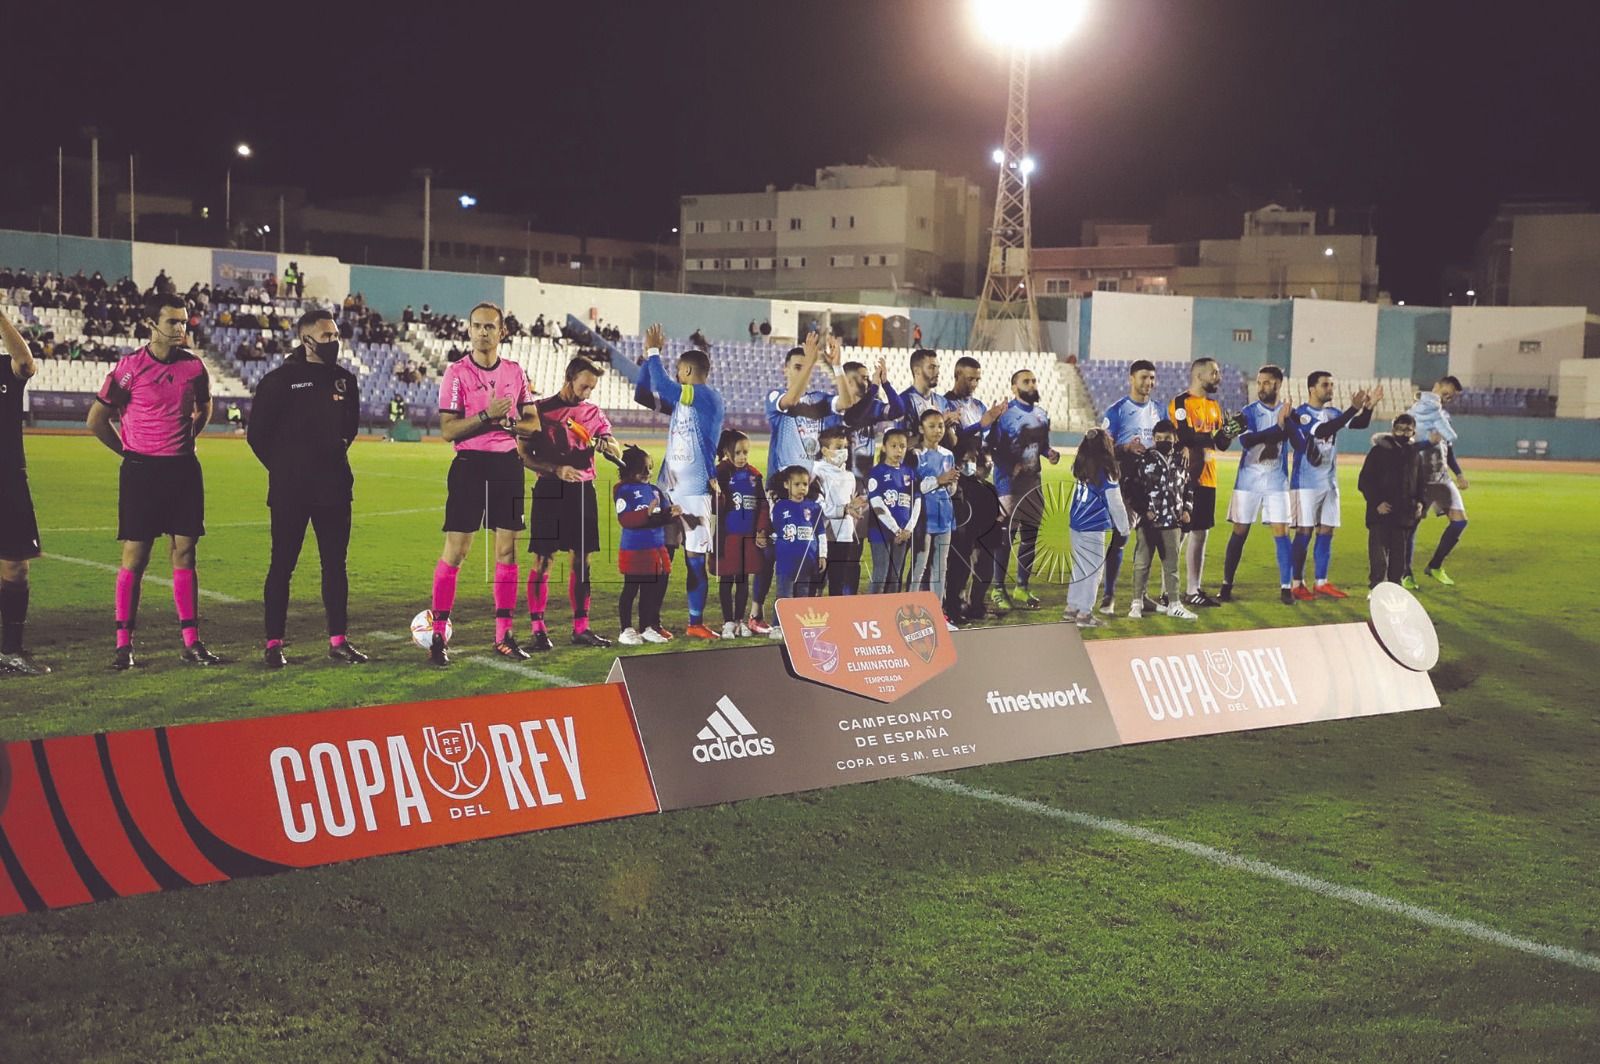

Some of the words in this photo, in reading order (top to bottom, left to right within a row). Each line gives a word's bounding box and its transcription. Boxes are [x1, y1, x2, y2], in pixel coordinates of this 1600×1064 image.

[853, 620, 882, 640] VS
[854, 645, 894, 656] PRIMERA
[847, 658, 911, 673] ELIMINATORIA
[863, 674, 903, 684] TEMPORADA
[1130, 654, 1220, 720] COPA
[1237, 647, 1298, 709] REY
[878, 685, 896, 693] 21/22
[986, 682, 1092, 715] finetwork
[1228, 702, 1249, 712] DEL
[838, 708, 953, 731] CAMPEONATO
[442, 737, 459, 746] RF
[855, 734, 878, 748] DE
[883, 725, 949, 745] ESPAÑA
[445, 746, 462, 755] EF
[692, 734, 776, 763] adidas
[836, 757, 874, 770] COPA
[878, 753, 897, 765] DE
[901, 750, 929, 763] S.M.
[932, 747, 950, 758] EL
[952, 744, 977, 755] REY
[269, 735, 433, 843] COPA
[449, 804, 491, 819] DEL
[487, 716, 587, 810] REY
